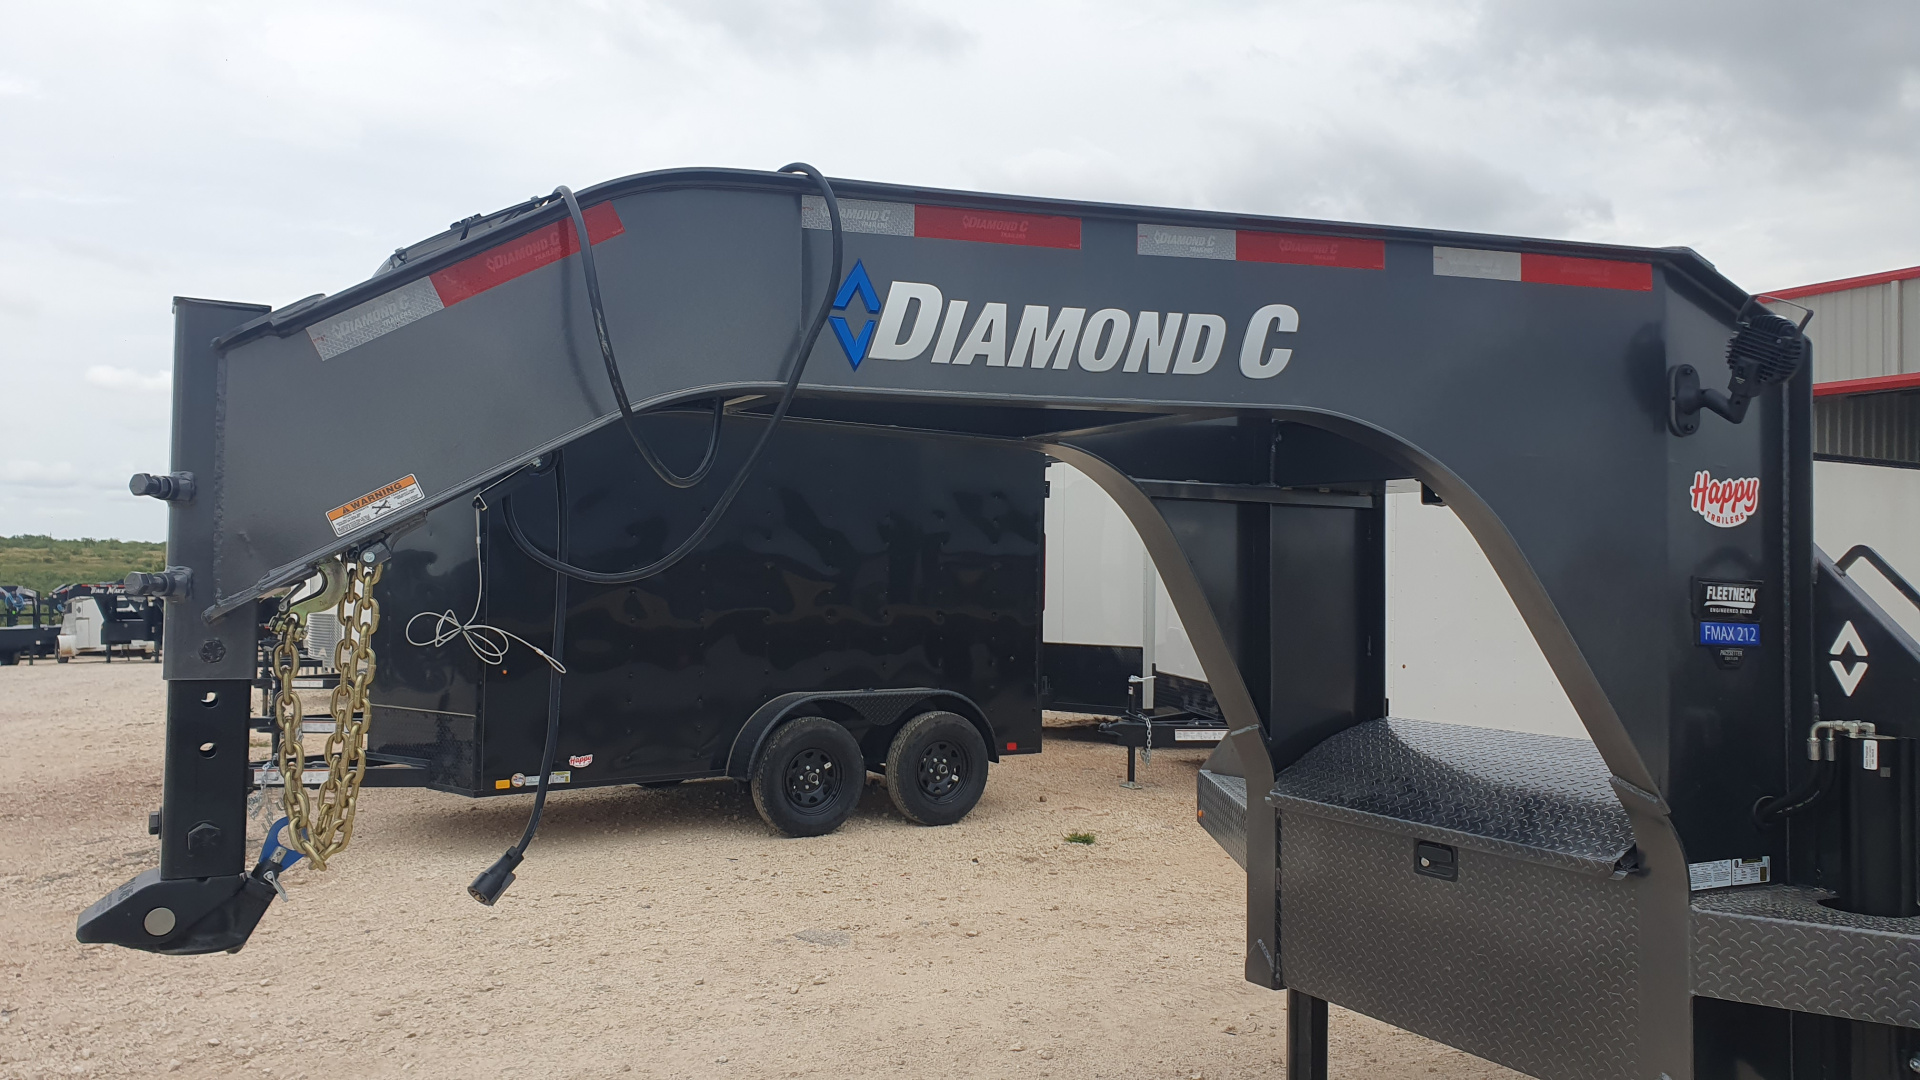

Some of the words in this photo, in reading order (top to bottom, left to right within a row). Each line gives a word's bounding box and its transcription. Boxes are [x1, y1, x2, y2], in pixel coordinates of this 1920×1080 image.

[881, 209, 891, 222] C
[968, 216, 1018, 231] DIAMOND
[1019, 220, 1029, 232] C
[1160, 232, 1206, 247] DIAMOND
[1207, 234, 1216, 247] C
[493, 238, 549, 270] DIAMOND
[549, 231, 561, 247] C
[340, 302, 399, 336] DIAMOND
[867, 280, 1227, 375] DIAMOND
[1238, 303, 1300, 379] C
[350, 482, 403, 510] WARNING
[1691, 472, 1758, 514] Happy
[1707, 511, 1745, 524] TRAILERS
[1706, 585, 1757, 602] FLEETNECK
[1704, 625, 1736, 641] FMAX
[1736, 626, 1756, 642] 212
[570, 755, 592, 765] Happy
